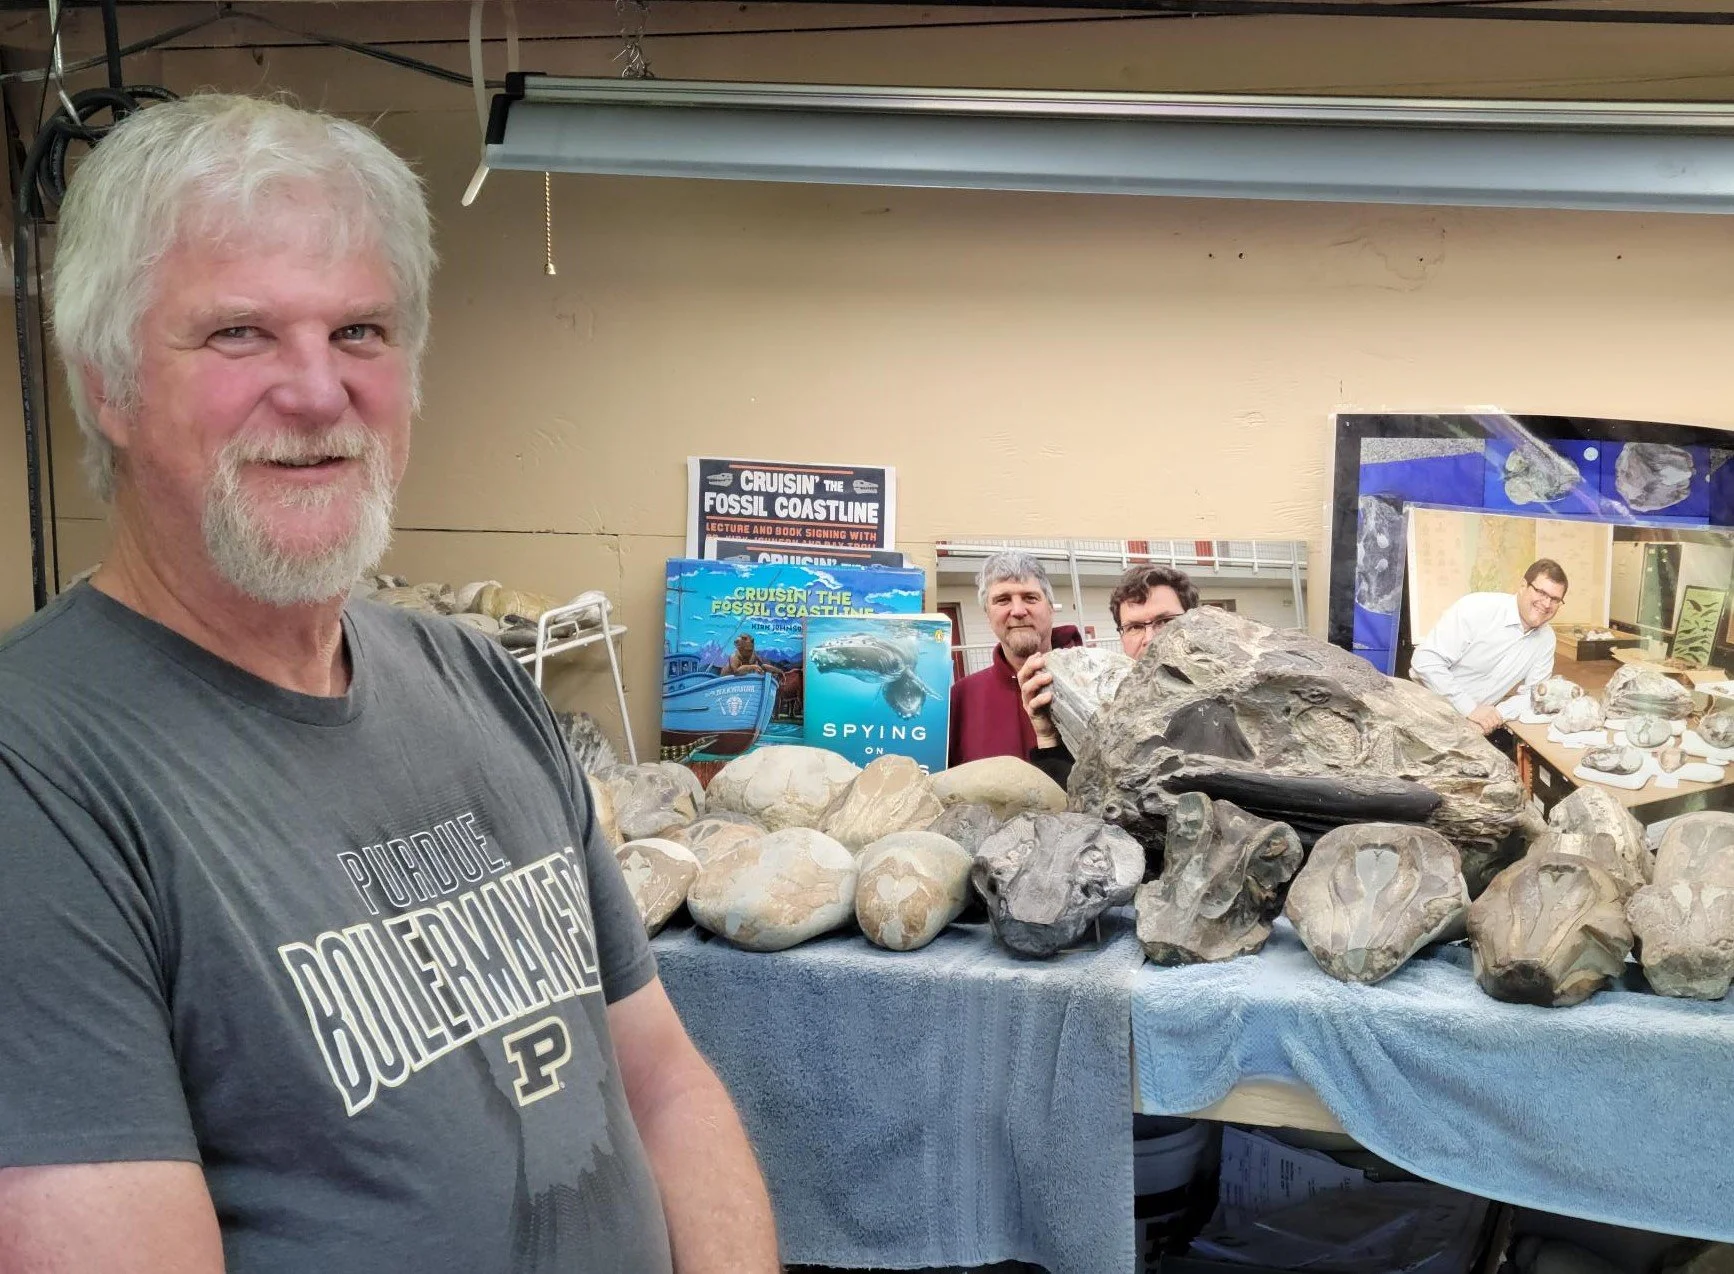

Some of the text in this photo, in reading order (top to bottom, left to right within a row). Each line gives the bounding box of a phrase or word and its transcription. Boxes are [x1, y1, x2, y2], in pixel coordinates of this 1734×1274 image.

[740, 470, 844, 495] CRUISIN' THE
[704, 491, 880, 524] FOSSIL COASTLINE
[705, 522, 750, 534] LECTURE
[752, 526, 773, 535] AND
[775, 527, 802, 537] BOOK
[805, 529, 847, 540] SIGNING
[849, 533, 877, 541] WITH
[734, 587, 852, 606] CRUISIN' THE
[711, 600, 770, 617] FOSSIL
[772, 624, 802, 632] JOHNSO
[822, 722, 927, 741] SPYING
[865, 746, 884, 755] ON
[336, 812, 505, 916] PURDUE
[502, 1016, 572, 1107] P
